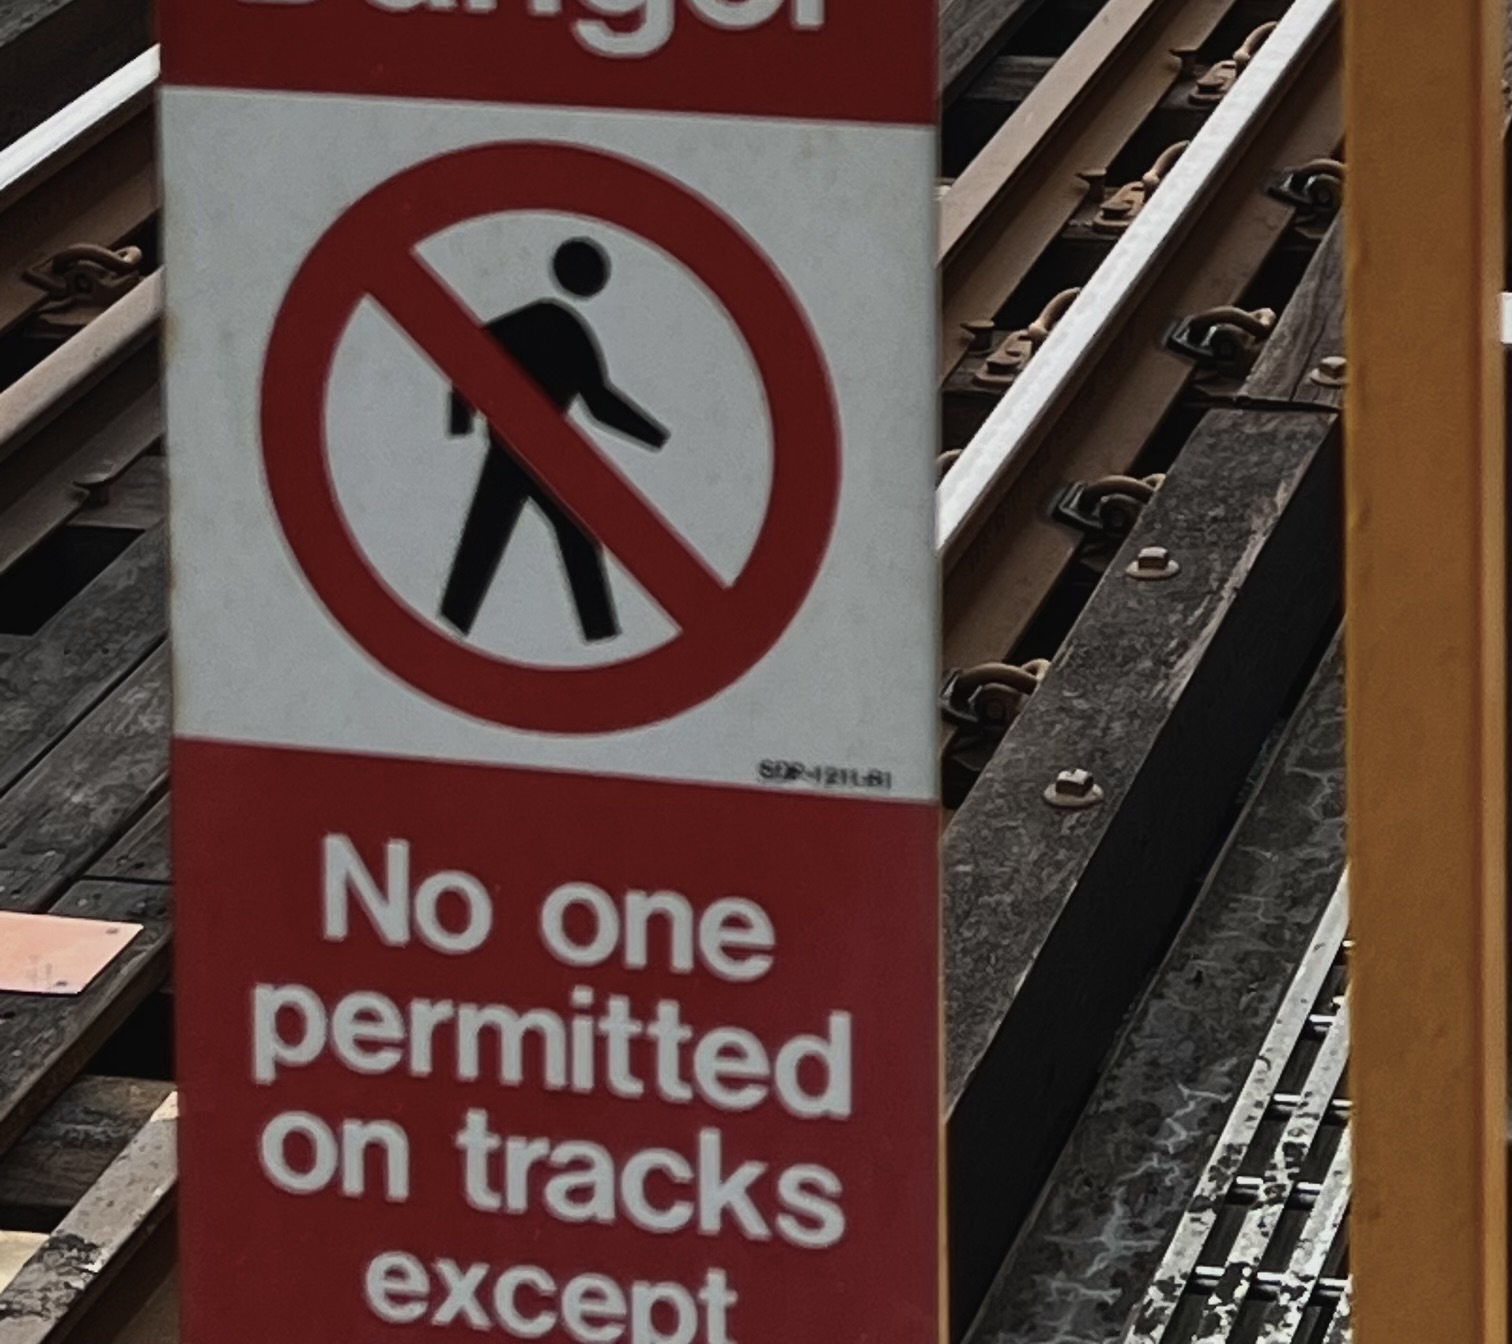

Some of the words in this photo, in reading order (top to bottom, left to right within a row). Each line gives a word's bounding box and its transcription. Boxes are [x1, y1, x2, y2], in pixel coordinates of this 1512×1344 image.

[322, 833, 493, 954] No
[540, 881, 776, 981] one
[251, 982, 852, 1119] permitted
[259, 1110, 410, 1202] on
[455, 1107, 846, 1249] tracks
[364, 1250, 739, 1344] except
